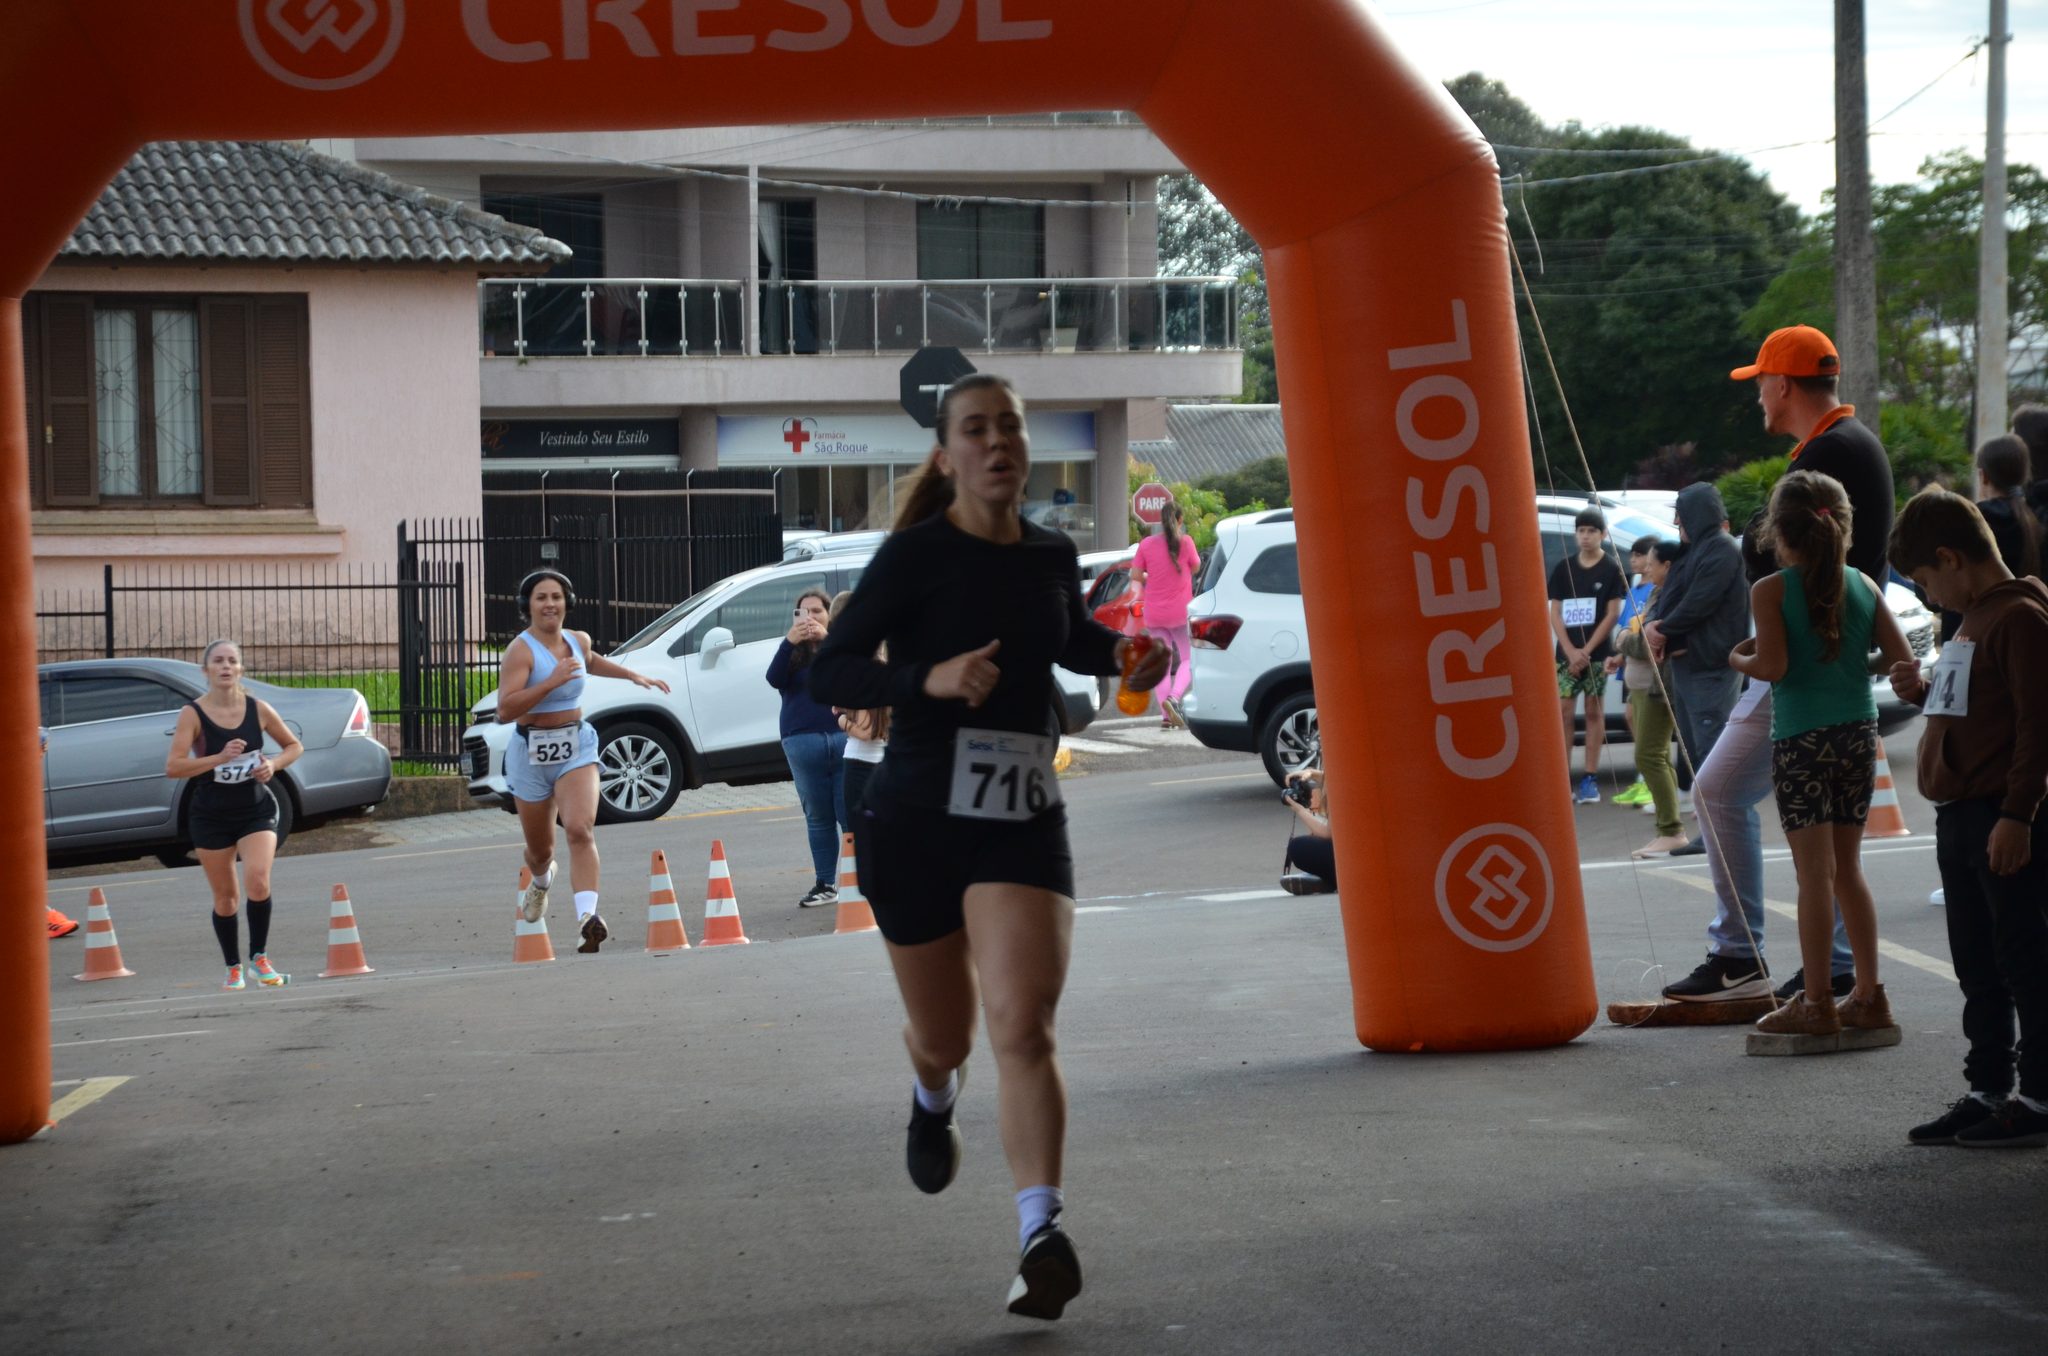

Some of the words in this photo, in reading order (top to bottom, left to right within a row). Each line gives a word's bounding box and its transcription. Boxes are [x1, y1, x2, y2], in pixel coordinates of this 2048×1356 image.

[540, 431, 588, 447] Vestindo
[591, 430, 612, 445] Seu
[616, 429, 649, 444] Estilo
[814, 431, 846, 440] Farmácia
[814, 442, 834, 453] São
[836, 442, 869, 453] Roque
[1388, 299, 1519, 779] CRESOL
[537, 742, 573, 762] 523
[970, 762, 1048, 813] 716
